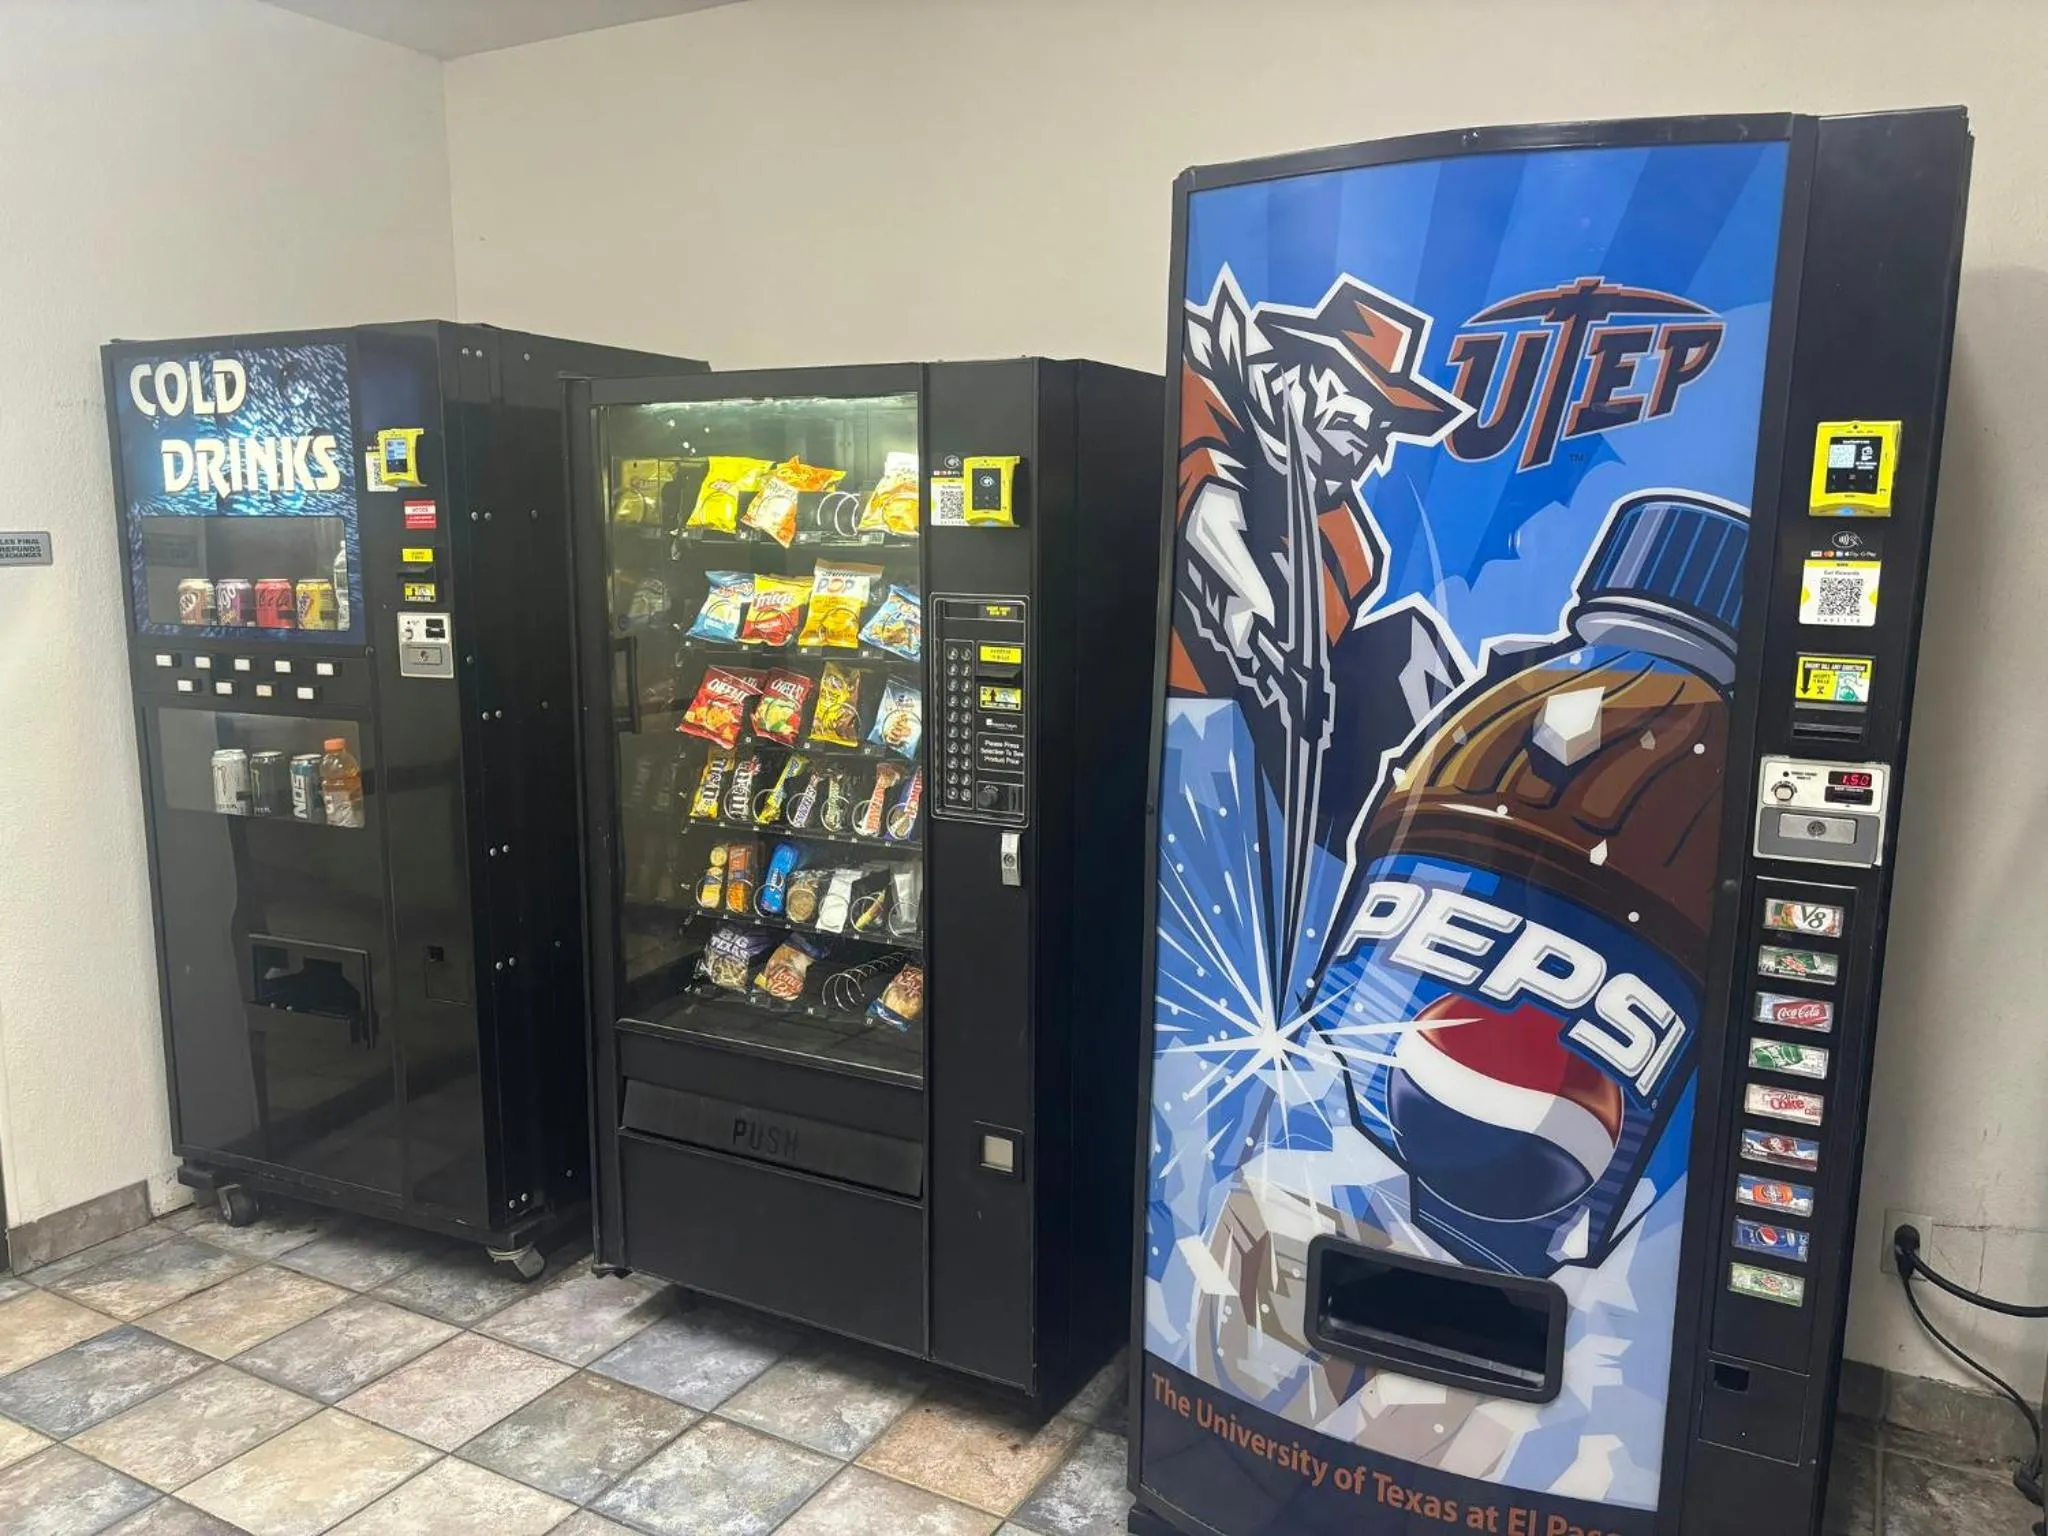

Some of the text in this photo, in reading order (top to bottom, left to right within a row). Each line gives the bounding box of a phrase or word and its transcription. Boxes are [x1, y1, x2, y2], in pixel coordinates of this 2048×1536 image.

[130, 359, 247, 417] COLD
[1444, 276, 1727, 474] UTEP
[161, 435, 341, 500] DRINKS
[291, 774, 308, 820] NOS
[719, 928, 749, 949] BIG
[1800, 904, 1826, 929] V8
[711, 934, 750, 960] TEXAS
[1337, 881, 1686, 1096] PEPSI
[1769, 1097, 1805, 1111] Coke
[733, 1118, 797, 1160] PUSH
[1152, 1372, 1623, 1536] The University of Texas at El Pa
